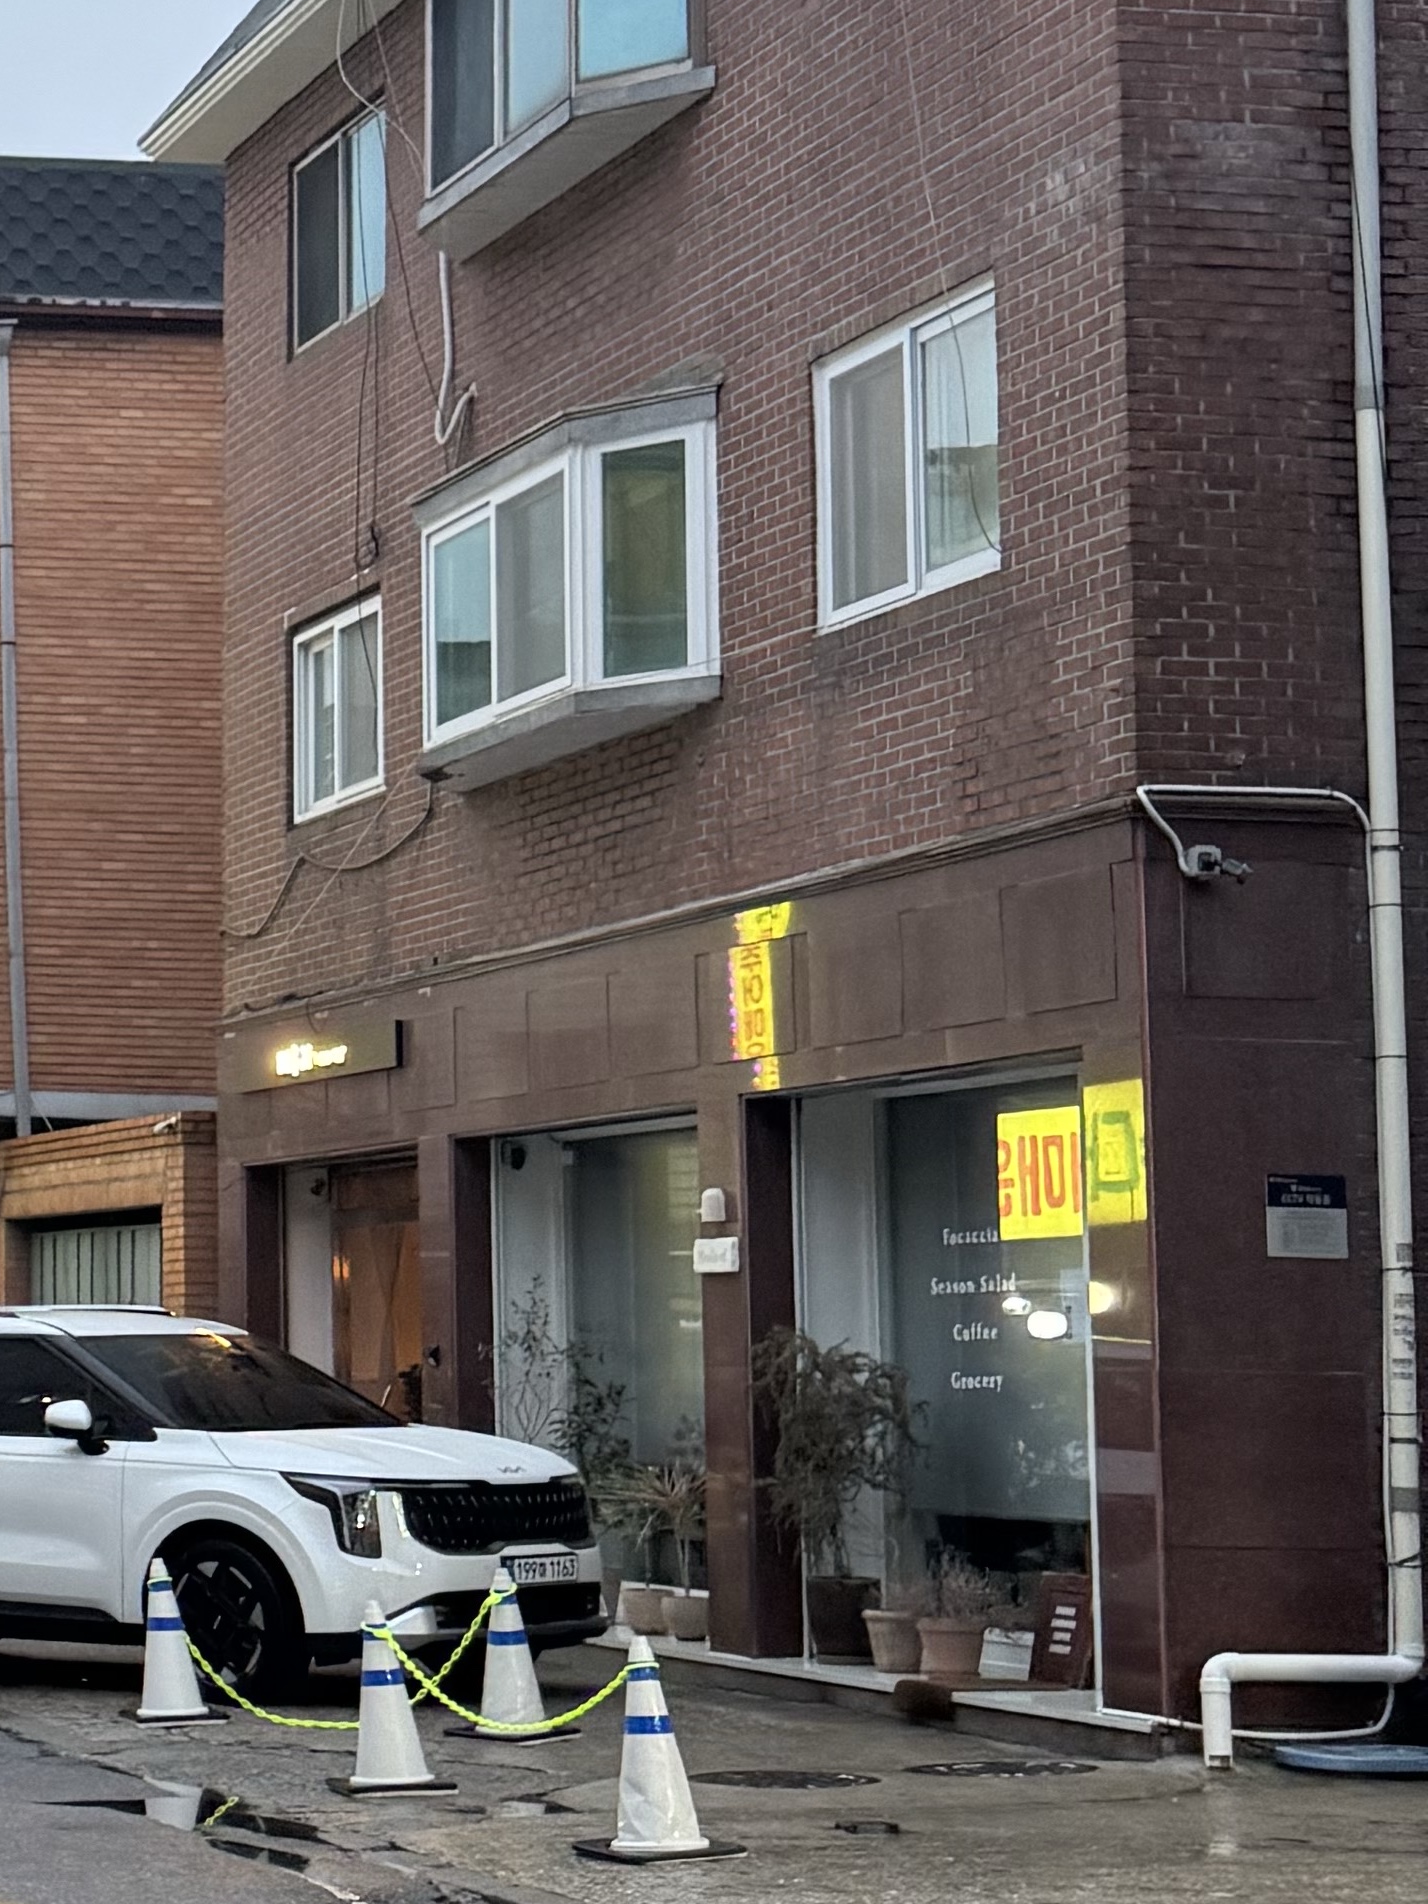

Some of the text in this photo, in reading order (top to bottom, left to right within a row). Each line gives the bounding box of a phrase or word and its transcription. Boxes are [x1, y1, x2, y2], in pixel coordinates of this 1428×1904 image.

[931, 1272, 1016, 1295] Season Salad
[953, 1322, 999, 1341] Coffee
[951, 1372, 1004, 1393] Grocery
